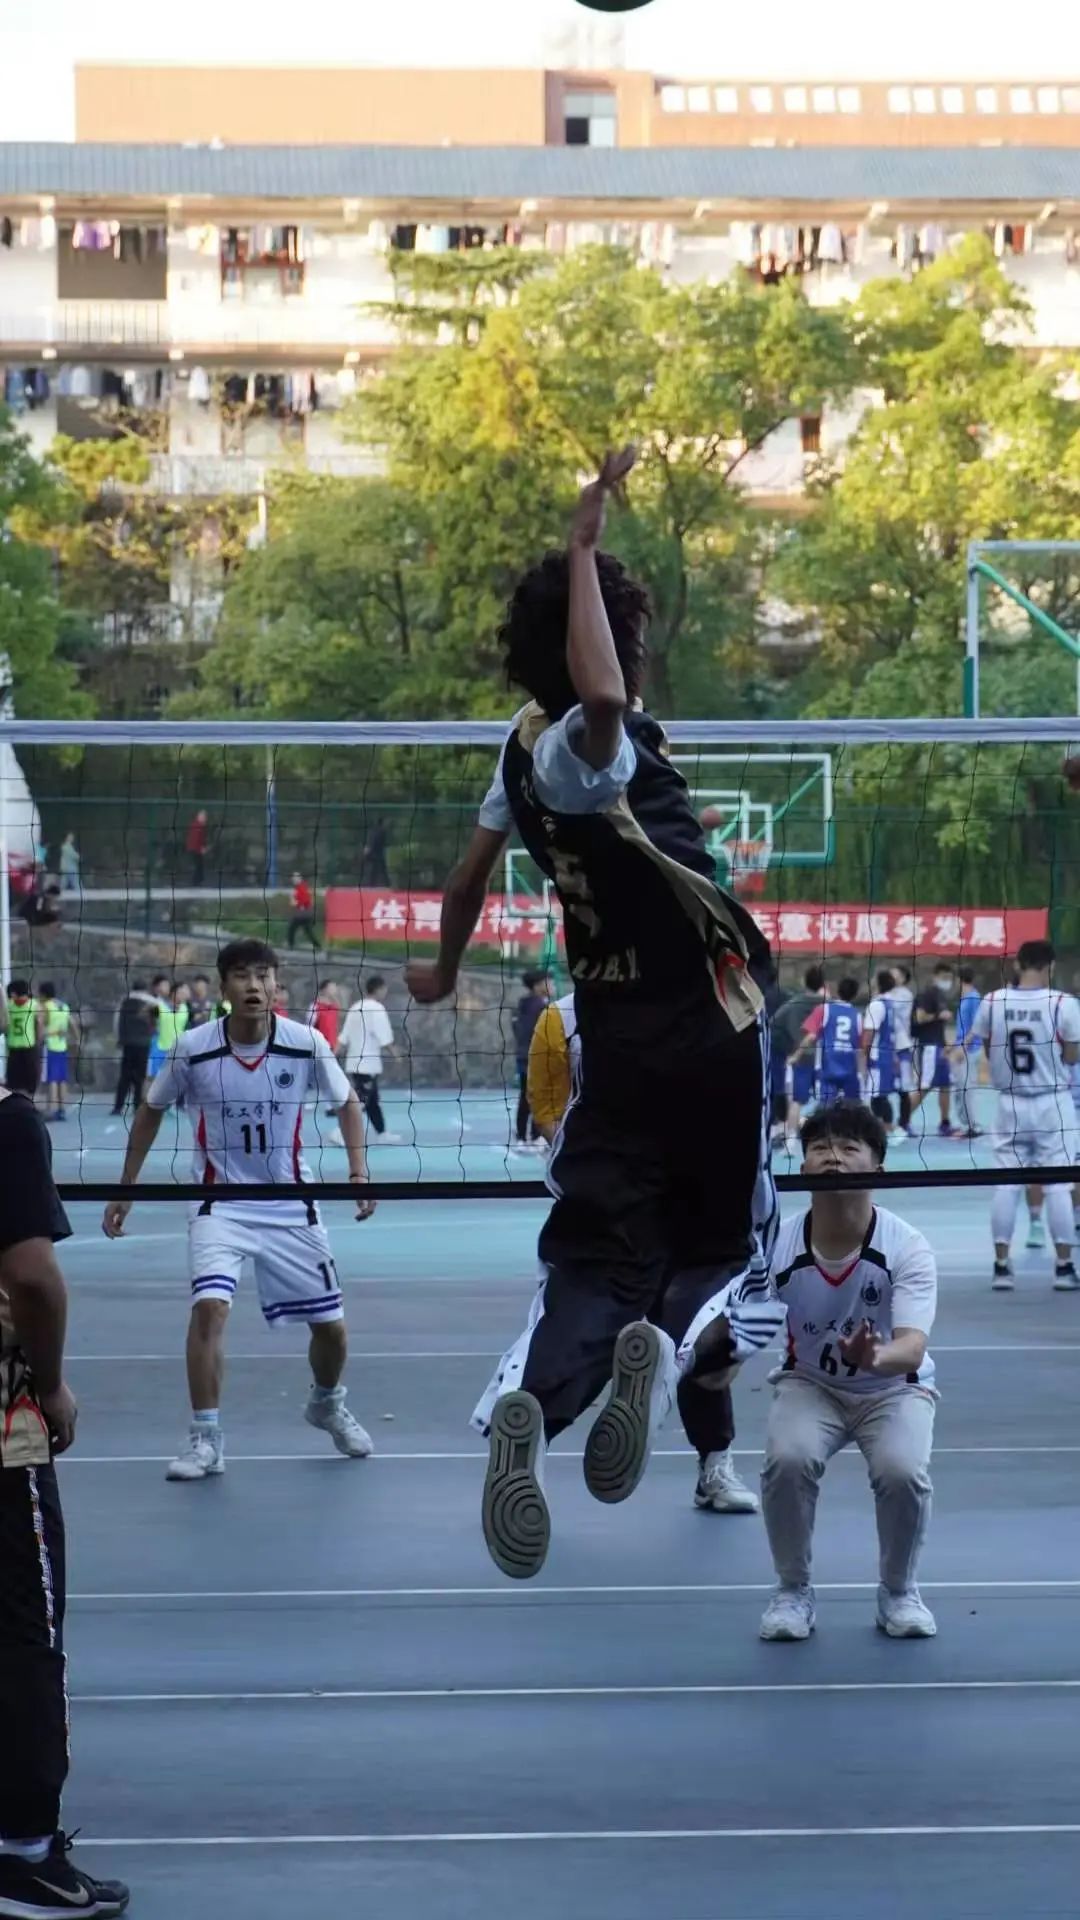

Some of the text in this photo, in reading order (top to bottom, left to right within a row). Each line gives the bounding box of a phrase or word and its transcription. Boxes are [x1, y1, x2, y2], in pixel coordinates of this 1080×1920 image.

[836, 1015, 852, 1040] 2
[1010, 1029, 1035, 1075] 6
[241, 1124, 267, 1154] 11
